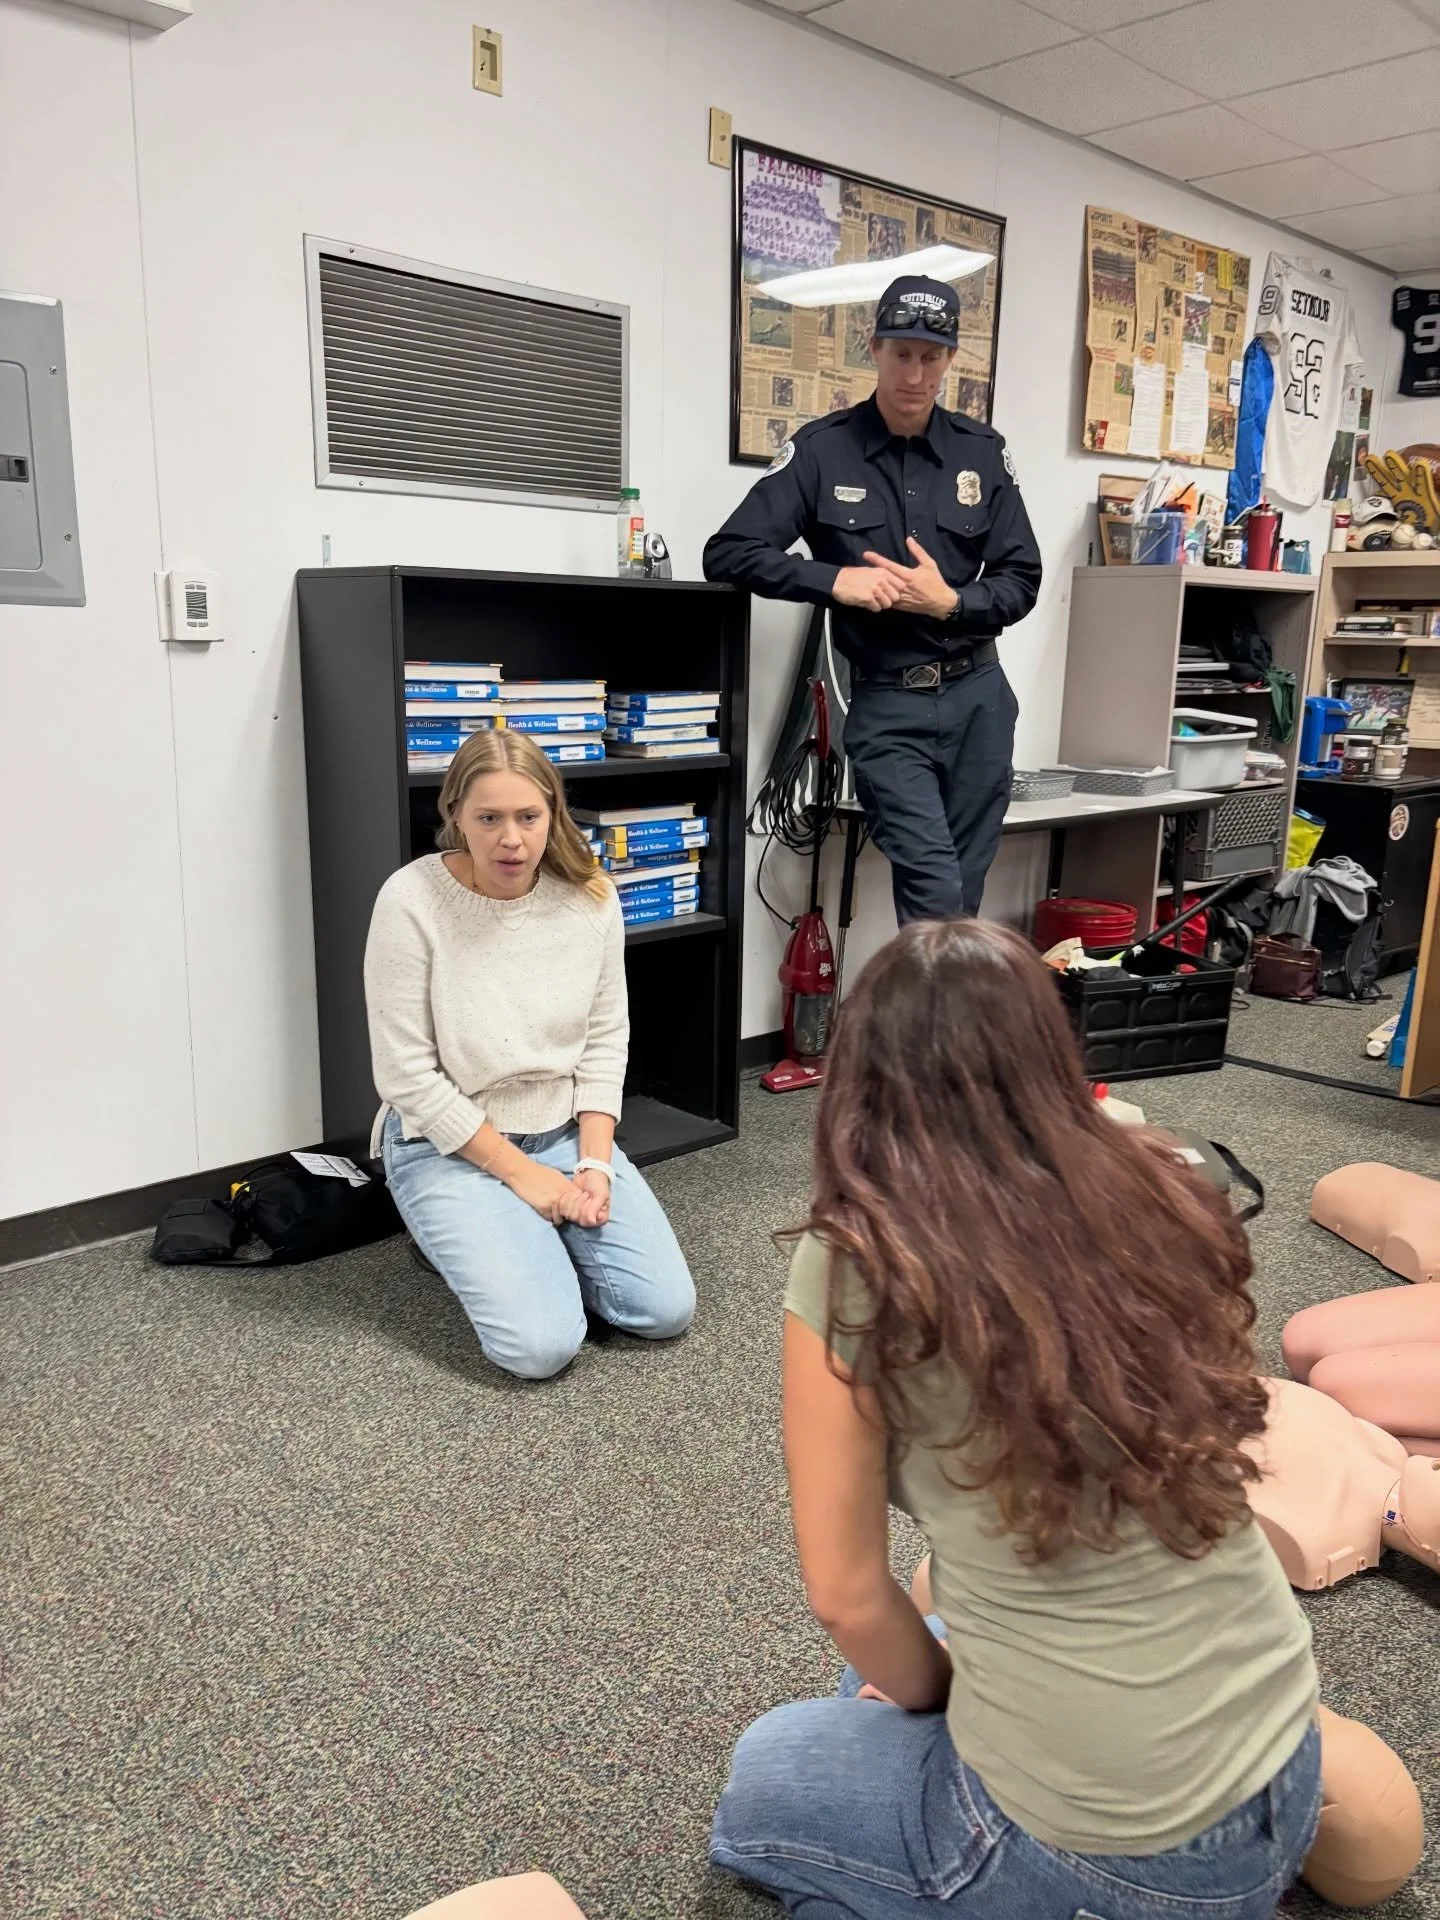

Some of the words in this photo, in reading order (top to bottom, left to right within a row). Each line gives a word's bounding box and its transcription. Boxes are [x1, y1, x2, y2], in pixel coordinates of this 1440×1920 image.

[899, 292, 925, 303] SCOTTS
[925, 293, 948, 308] VALLEY
[507, 721, 527, 729] Health
[533, 720, 557, 728] Wellness
[415, 738, 442, 746] Wellness
[627, 829, 644, 837] Health
[628, 844, 644, 853] Health
